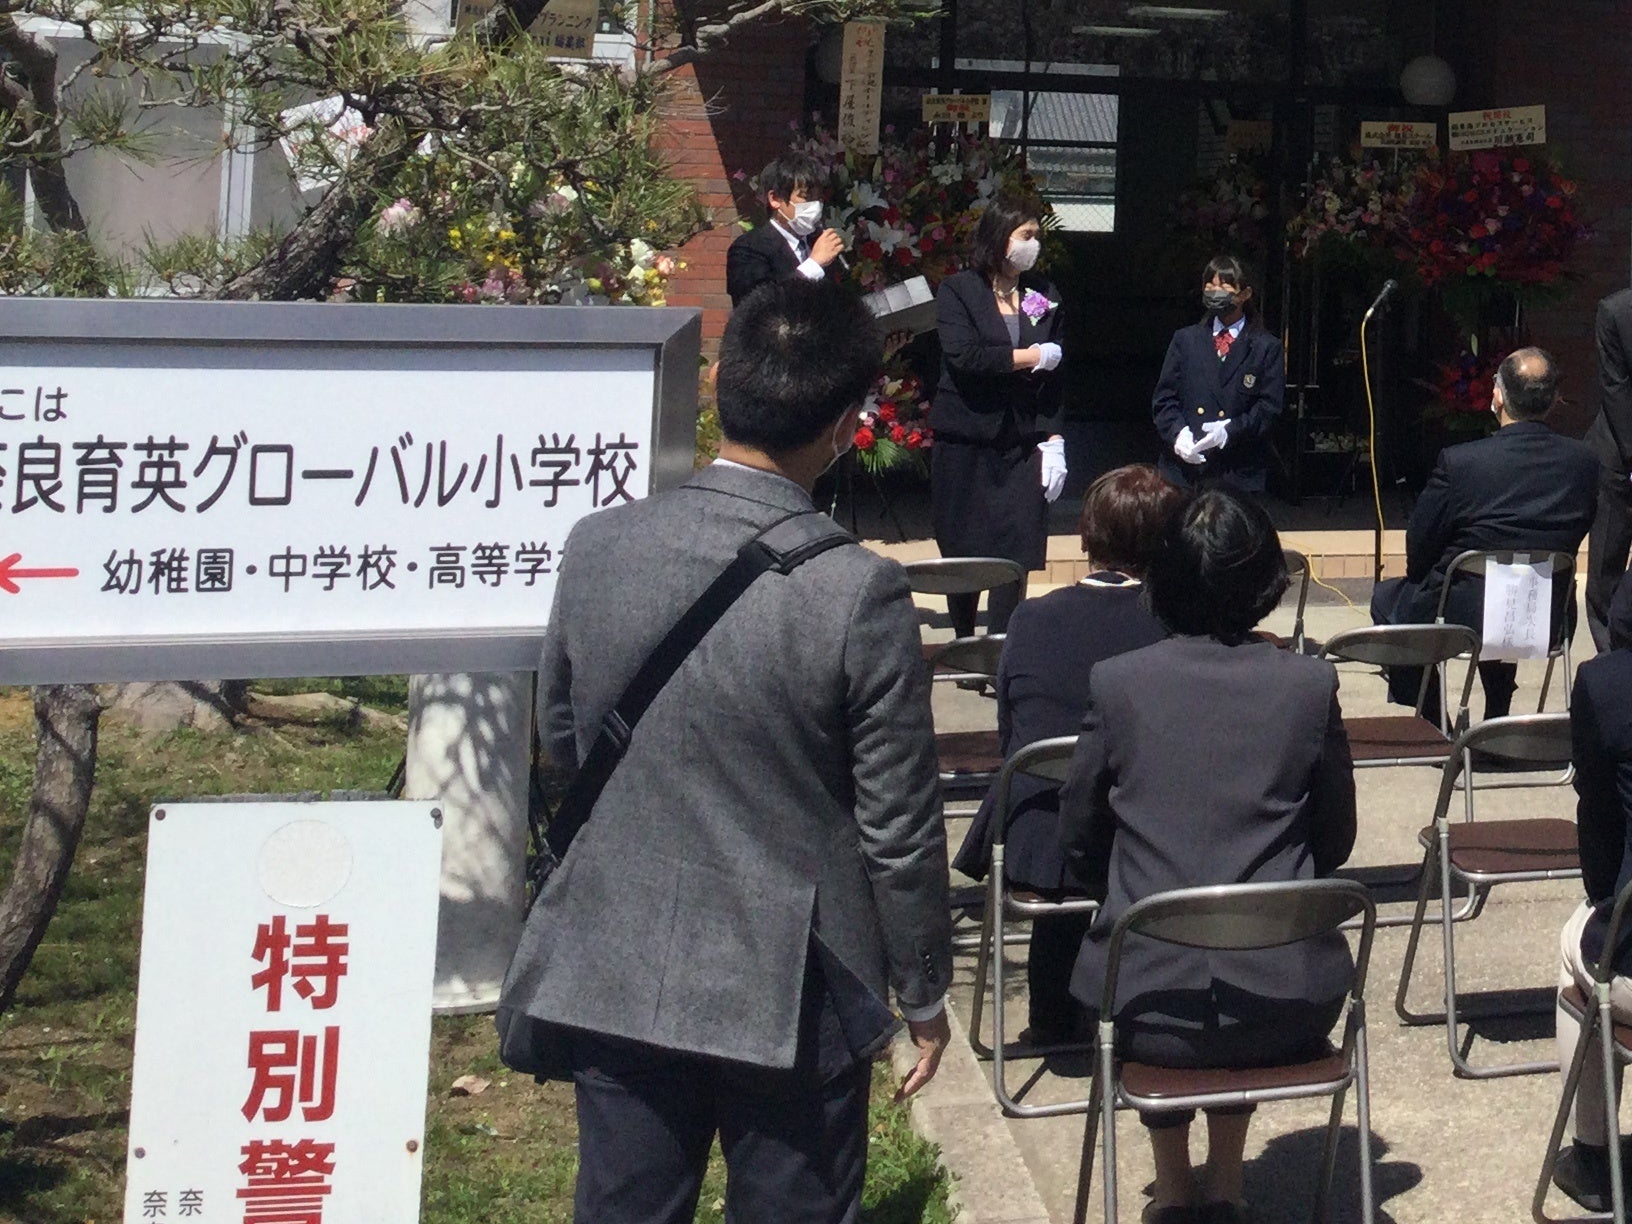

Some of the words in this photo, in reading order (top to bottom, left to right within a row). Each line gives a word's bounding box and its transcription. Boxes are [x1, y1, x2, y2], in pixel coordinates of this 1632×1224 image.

[0, 431, 640, 514] 良育英グローバル小学校
[142, 1189, 169, 1224] 奈
